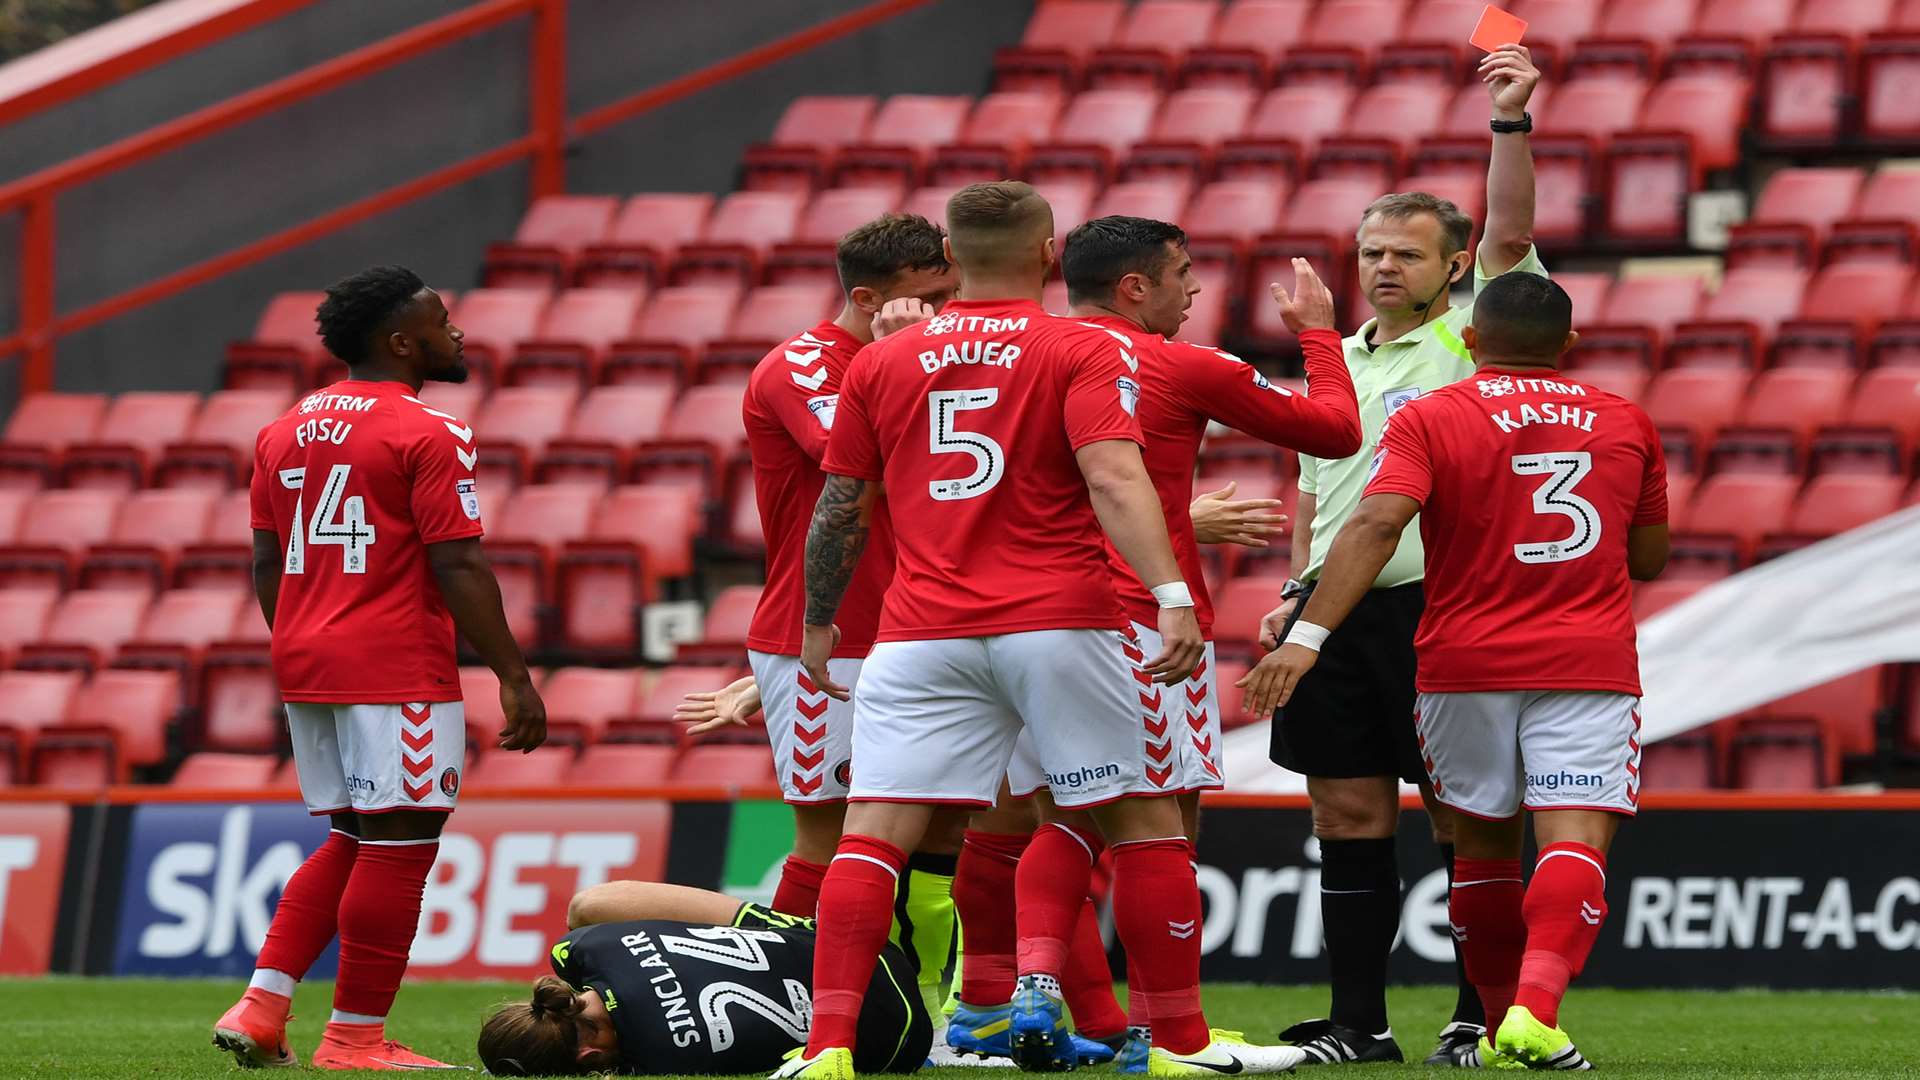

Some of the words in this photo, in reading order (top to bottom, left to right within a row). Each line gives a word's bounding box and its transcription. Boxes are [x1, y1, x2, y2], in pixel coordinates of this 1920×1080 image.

[956, 315, 1029, 334] ITRM
[918, 340, 1022, 375] BAUER
[317, 394, 379, 412] ITRM
[1517, 378, 1586, 397] ITRM
[296, 417, 353, 448] FOSU
[1490, 402, 1598, 433] KASHI
[928, 387, 1005, 501] 5
[1511, 451, 1602, 564] 3
[1041, 763, 1120, 788] aughan
[1524, 770, 1603, 790] aughan
[139, 805, 304, 958] sk
[407, 832, 637, 967] BET
[1622, 875, 1920, 950] RENT-A-C
[620, 930, 701, 1049] SINCLAIR
